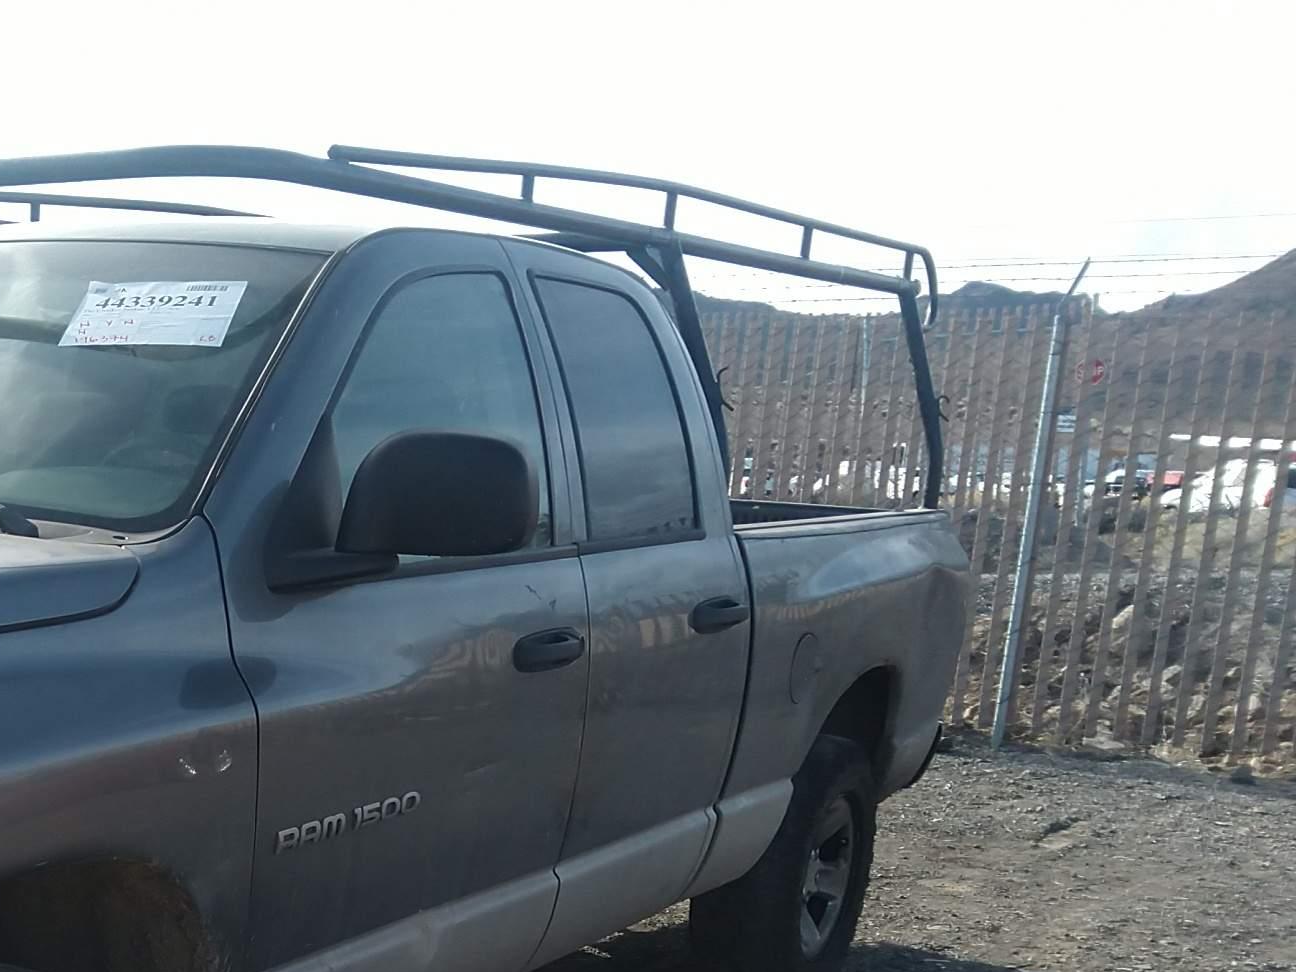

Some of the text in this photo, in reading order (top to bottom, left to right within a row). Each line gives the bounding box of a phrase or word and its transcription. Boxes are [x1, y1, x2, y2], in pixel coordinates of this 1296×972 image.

[95, 295, 218, 309] 44339241
[1077, 365, 1104, 377] SOP
[275, 791, 421, 855] RAM 1500
